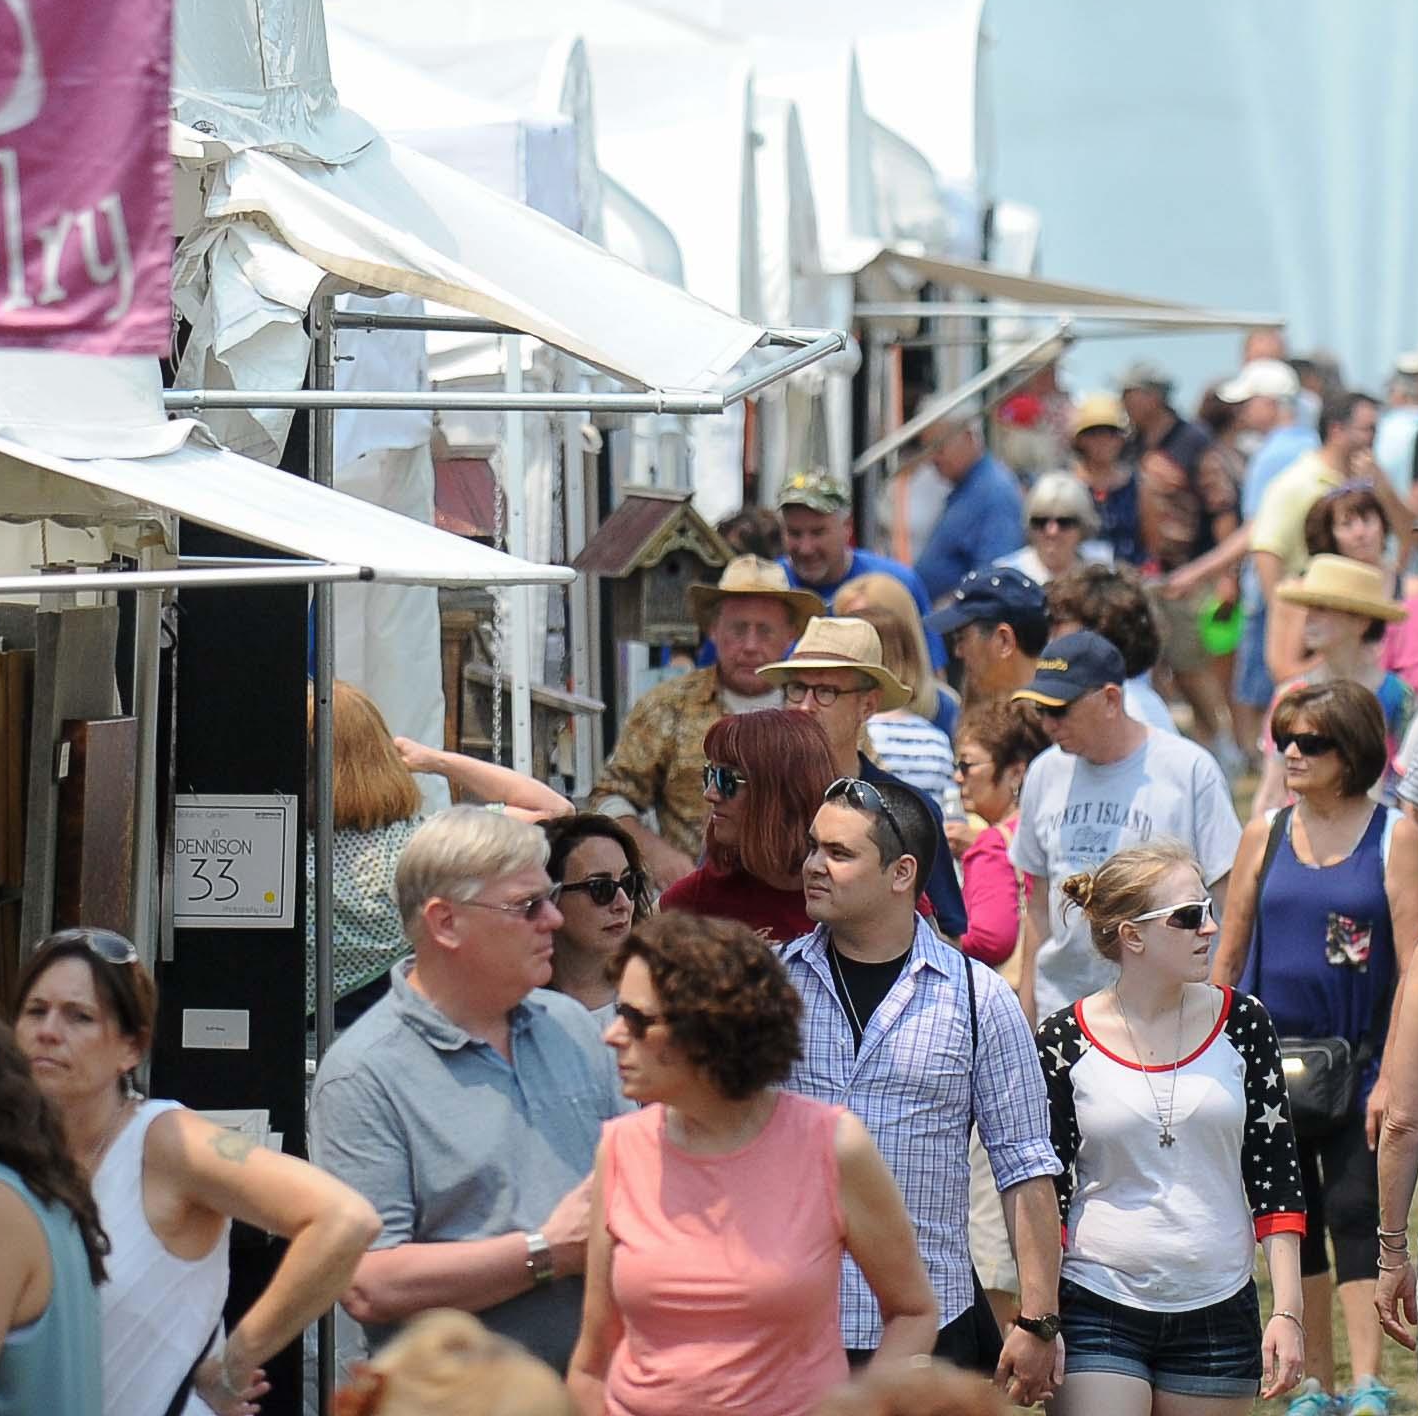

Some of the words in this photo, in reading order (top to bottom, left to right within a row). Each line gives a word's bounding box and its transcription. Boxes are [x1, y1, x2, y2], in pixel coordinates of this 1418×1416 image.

[1096, 801, 1153, 841] ISLAND
[176, 839, 252, 855] DENNISON
[188, 858, 239, 902] 33
